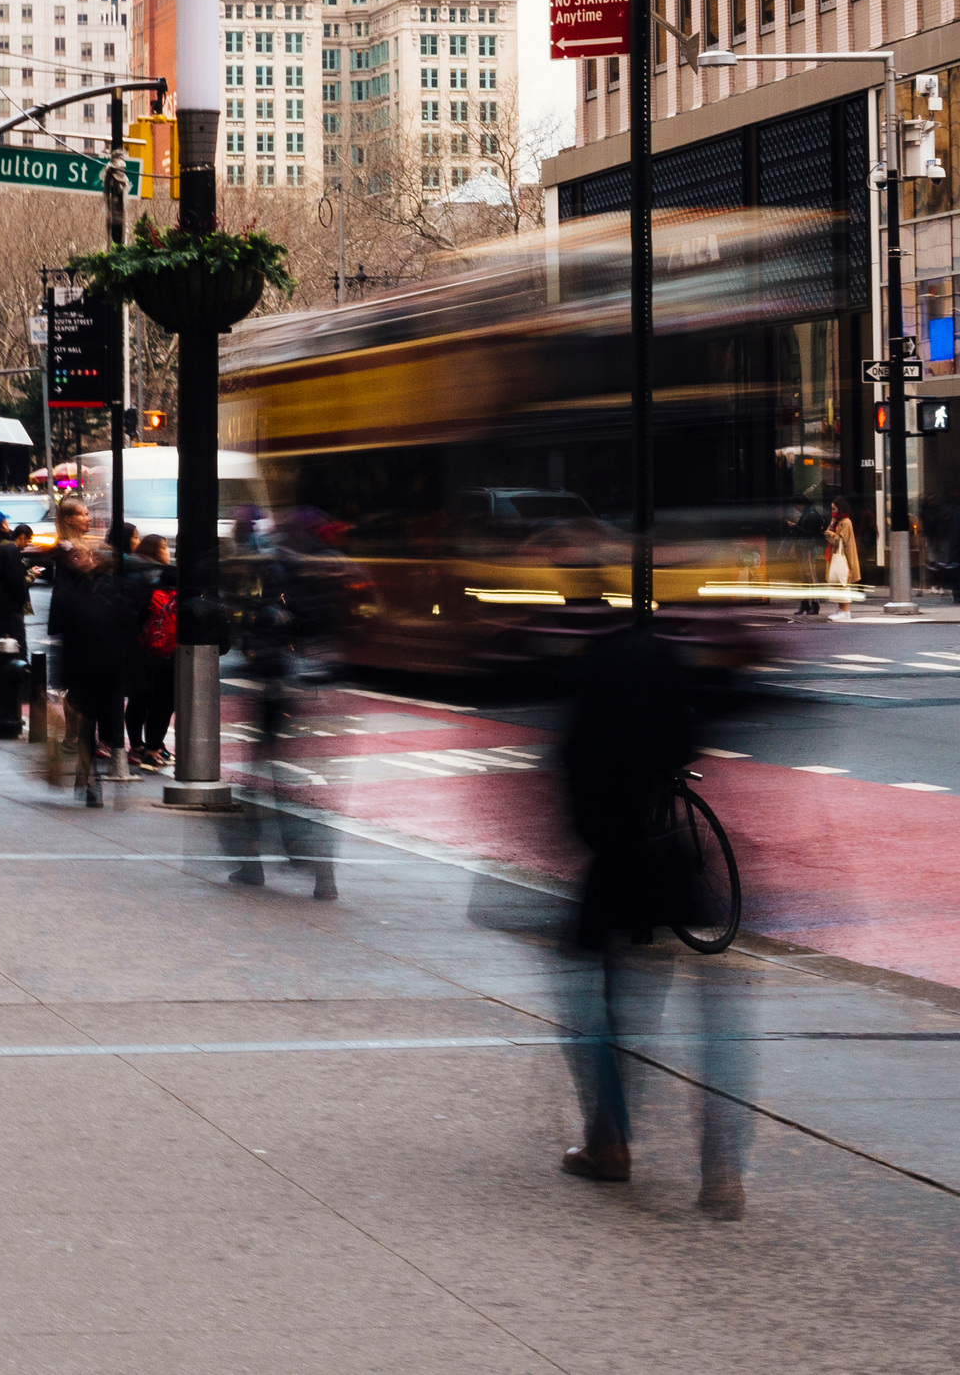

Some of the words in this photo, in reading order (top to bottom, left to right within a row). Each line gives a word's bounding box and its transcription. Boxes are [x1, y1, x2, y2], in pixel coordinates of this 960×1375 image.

[555, 8, 603, 26] Anytime
[68, 161, 88, 184] St
[54, 346, 66, 354] CITY
[68, 346, 82, 354] HALL
[903, 367, 916, 376] AY
